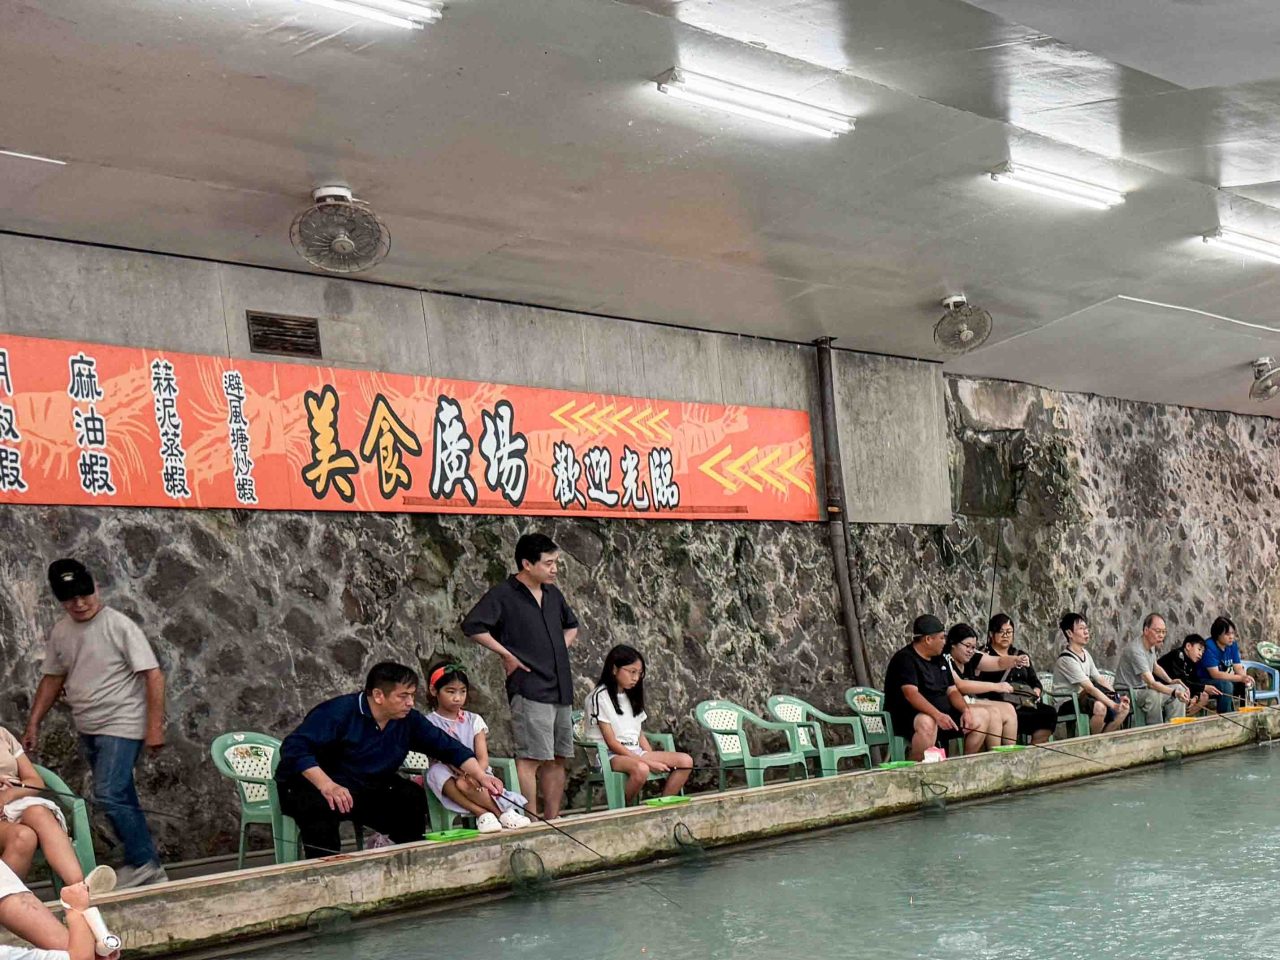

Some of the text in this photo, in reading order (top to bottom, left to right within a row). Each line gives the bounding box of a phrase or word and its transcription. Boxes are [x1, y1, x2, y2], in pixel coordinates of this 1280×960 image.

[68, 353, 116, 495] 麻油蝦
[152, 360, 190, 497] 蒜泥蒸蝦
[223, 371, 257, 503] 避風塘炒蝦
[303, 384, 528, 505] 美食廣場
[552, 442, 680, 510] 歡迎光臨
